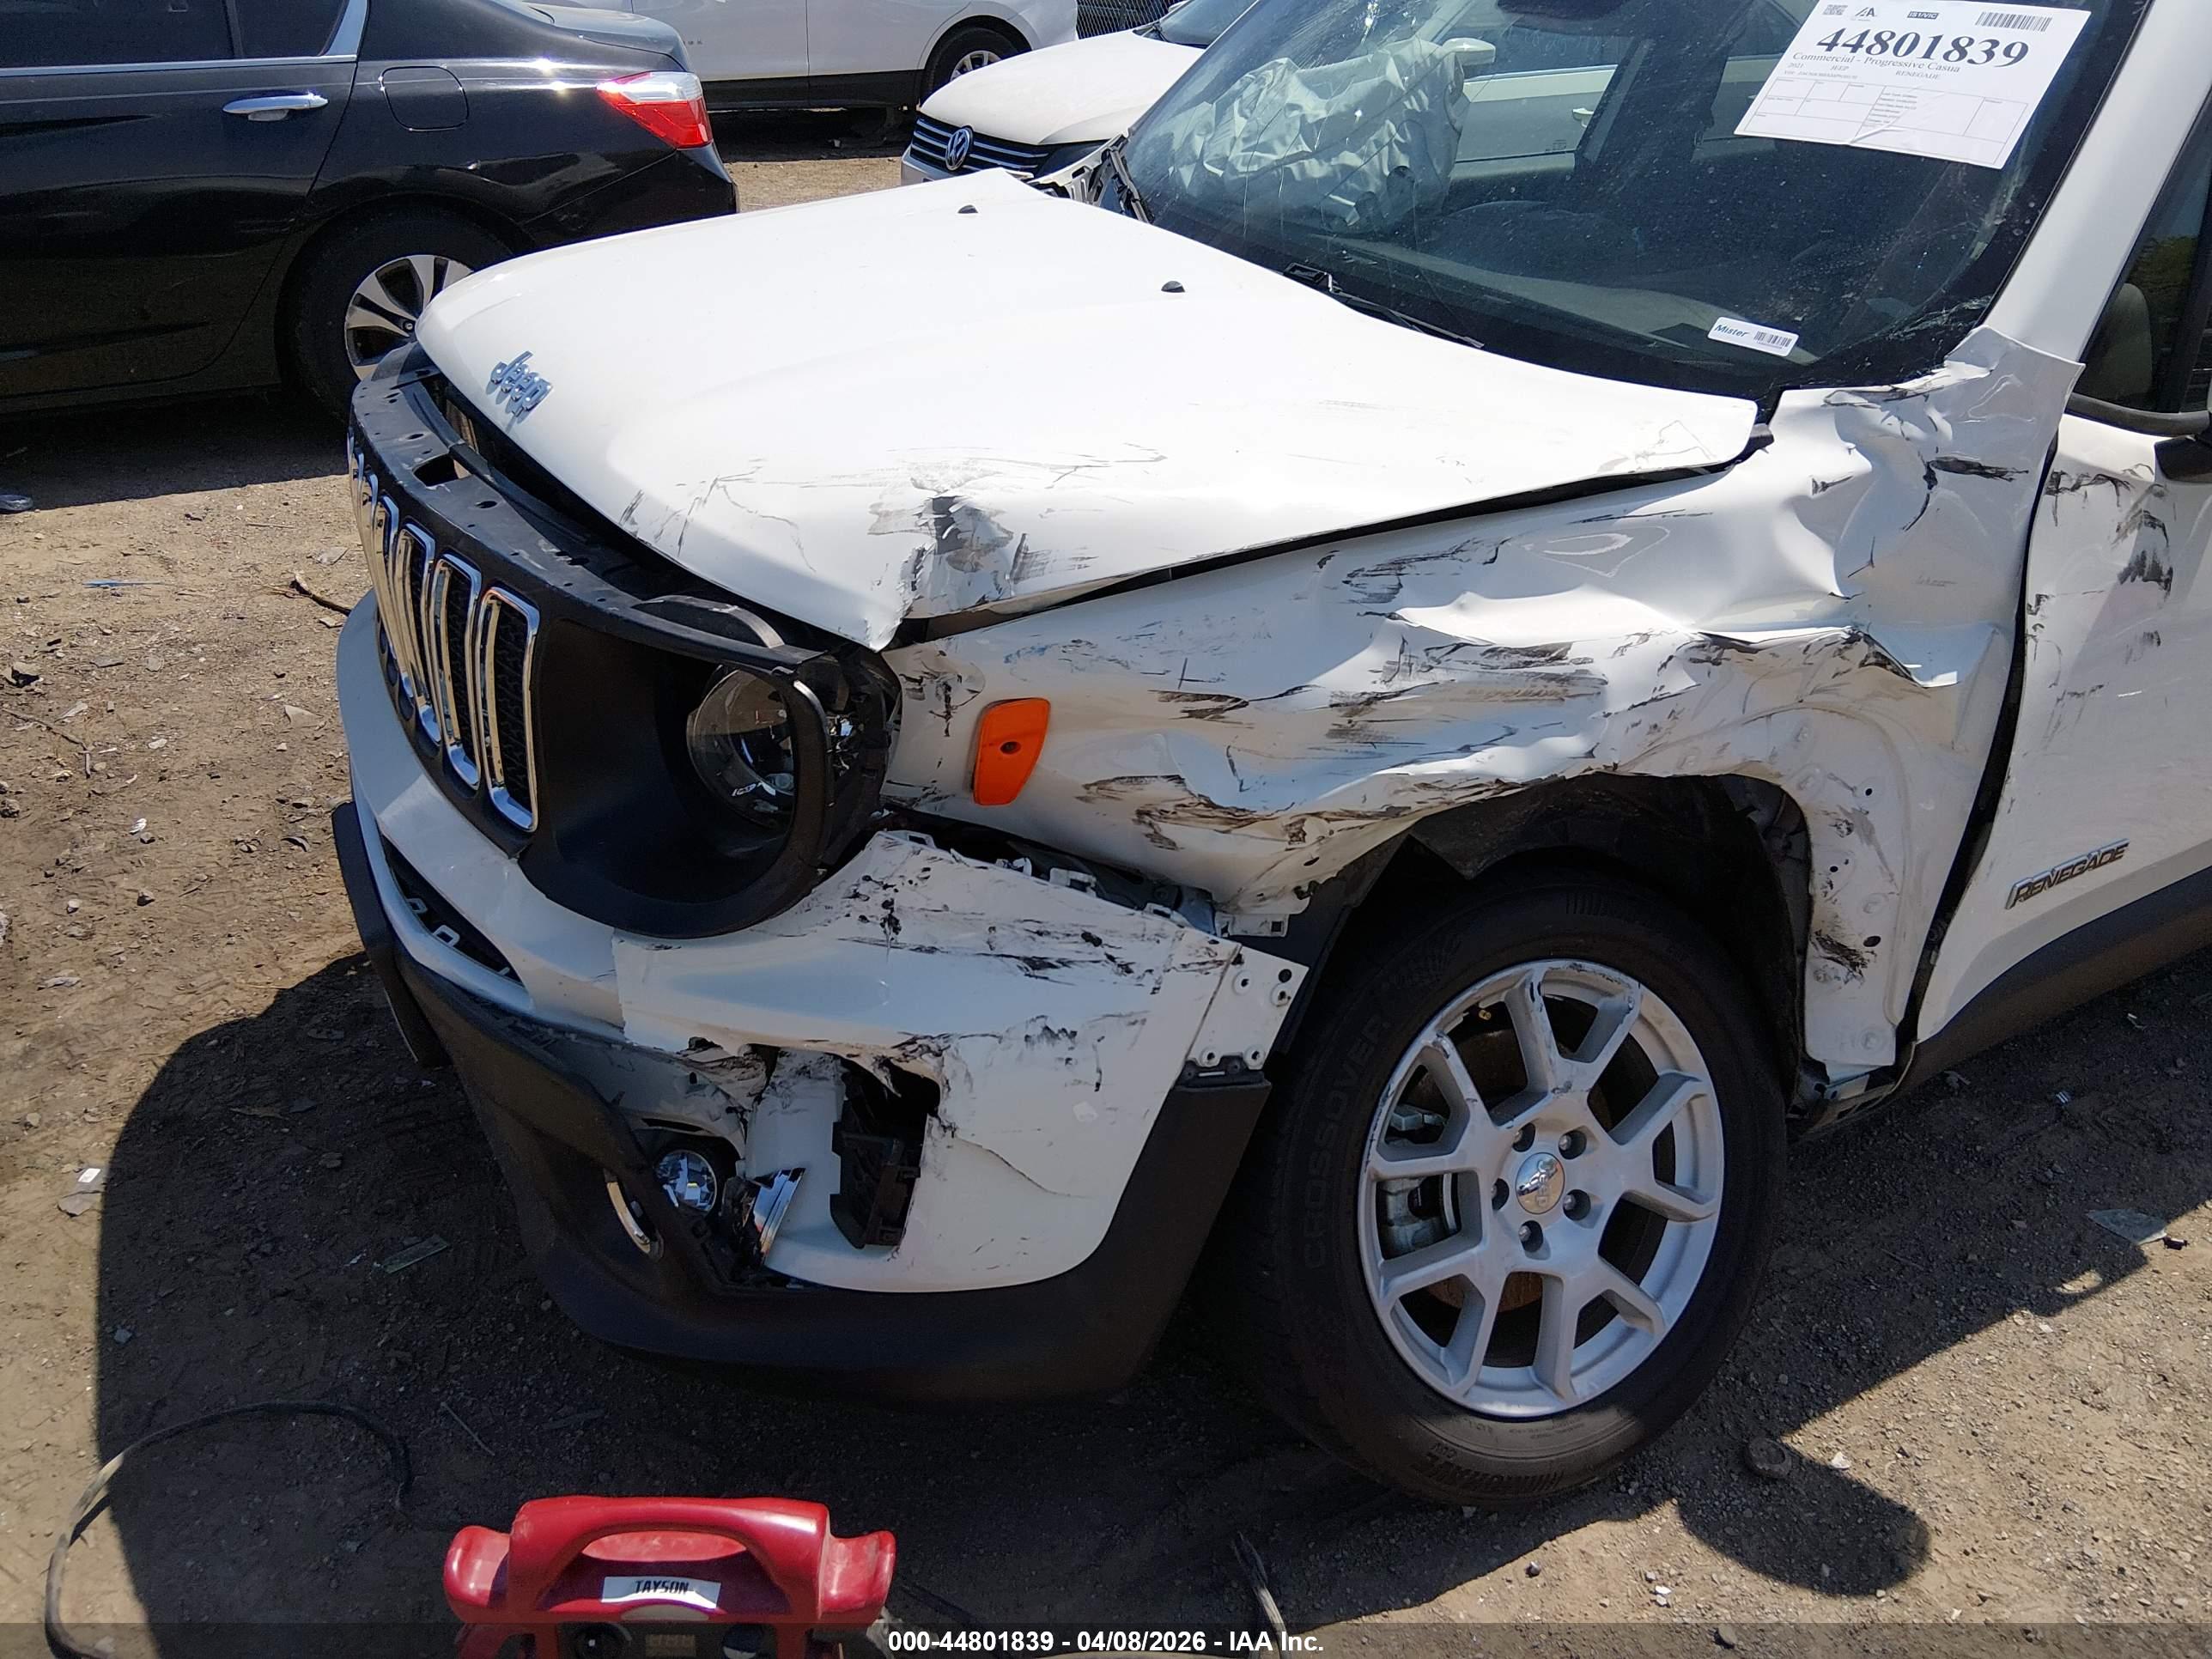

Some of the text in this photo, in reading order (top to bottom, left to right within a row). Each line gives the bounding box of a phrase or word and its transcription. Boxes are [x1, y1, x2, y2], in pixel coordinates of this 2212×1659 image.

[1816, 27, 2029, 68] 44801839
[1793, 52, 1855, 64] Commercial
[1863, 56, 1926, 70] Progressive
[1927, 63, 1960, 73] Casua
[1895, 70, 1941, 80] RENEGADE
[1714, 324, 1751, 338] Mister
[635, 1579, 690, 1595] TAYSON
